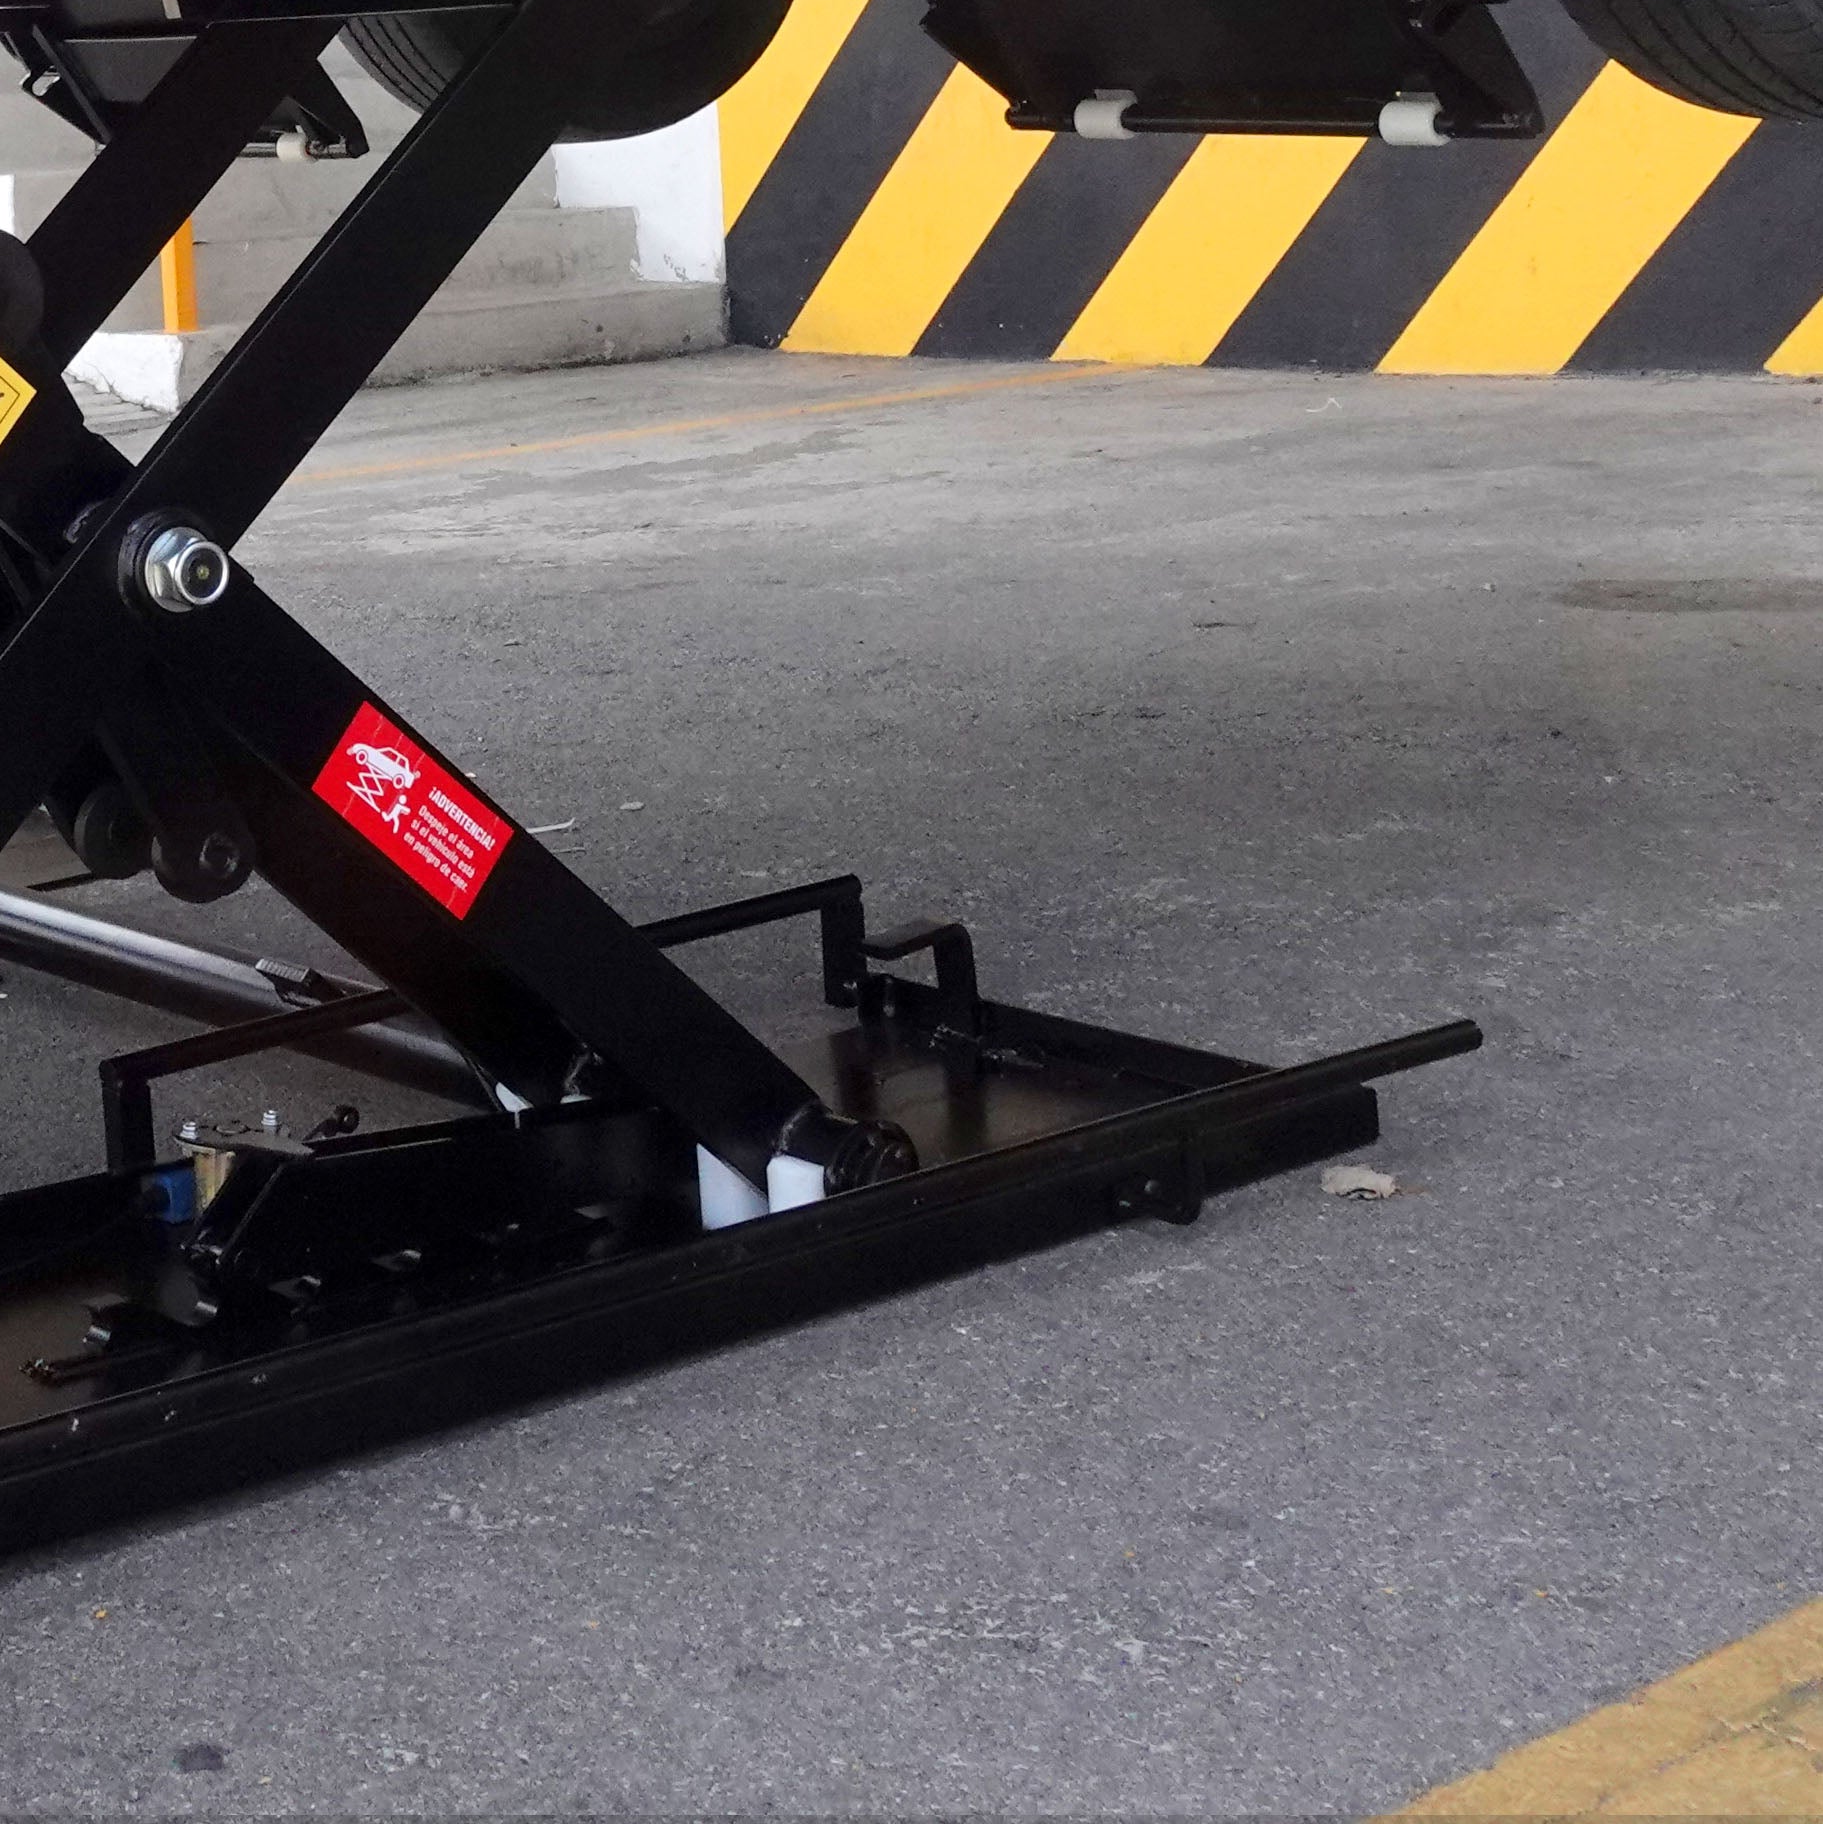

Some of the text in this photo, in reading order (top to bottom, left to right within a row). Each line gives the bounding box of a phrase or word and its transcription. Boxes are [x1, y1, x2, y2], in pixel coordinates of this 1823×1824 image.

[419, 826, 430, 838] el
[428, 786, 496, 851] ¡ADVERTENCIA!
[448, 833, 459, 844] el
[403, 832, 415, 845] en
[412, 840, 441, 868] peligro
[440, 863, 452, 877] de
